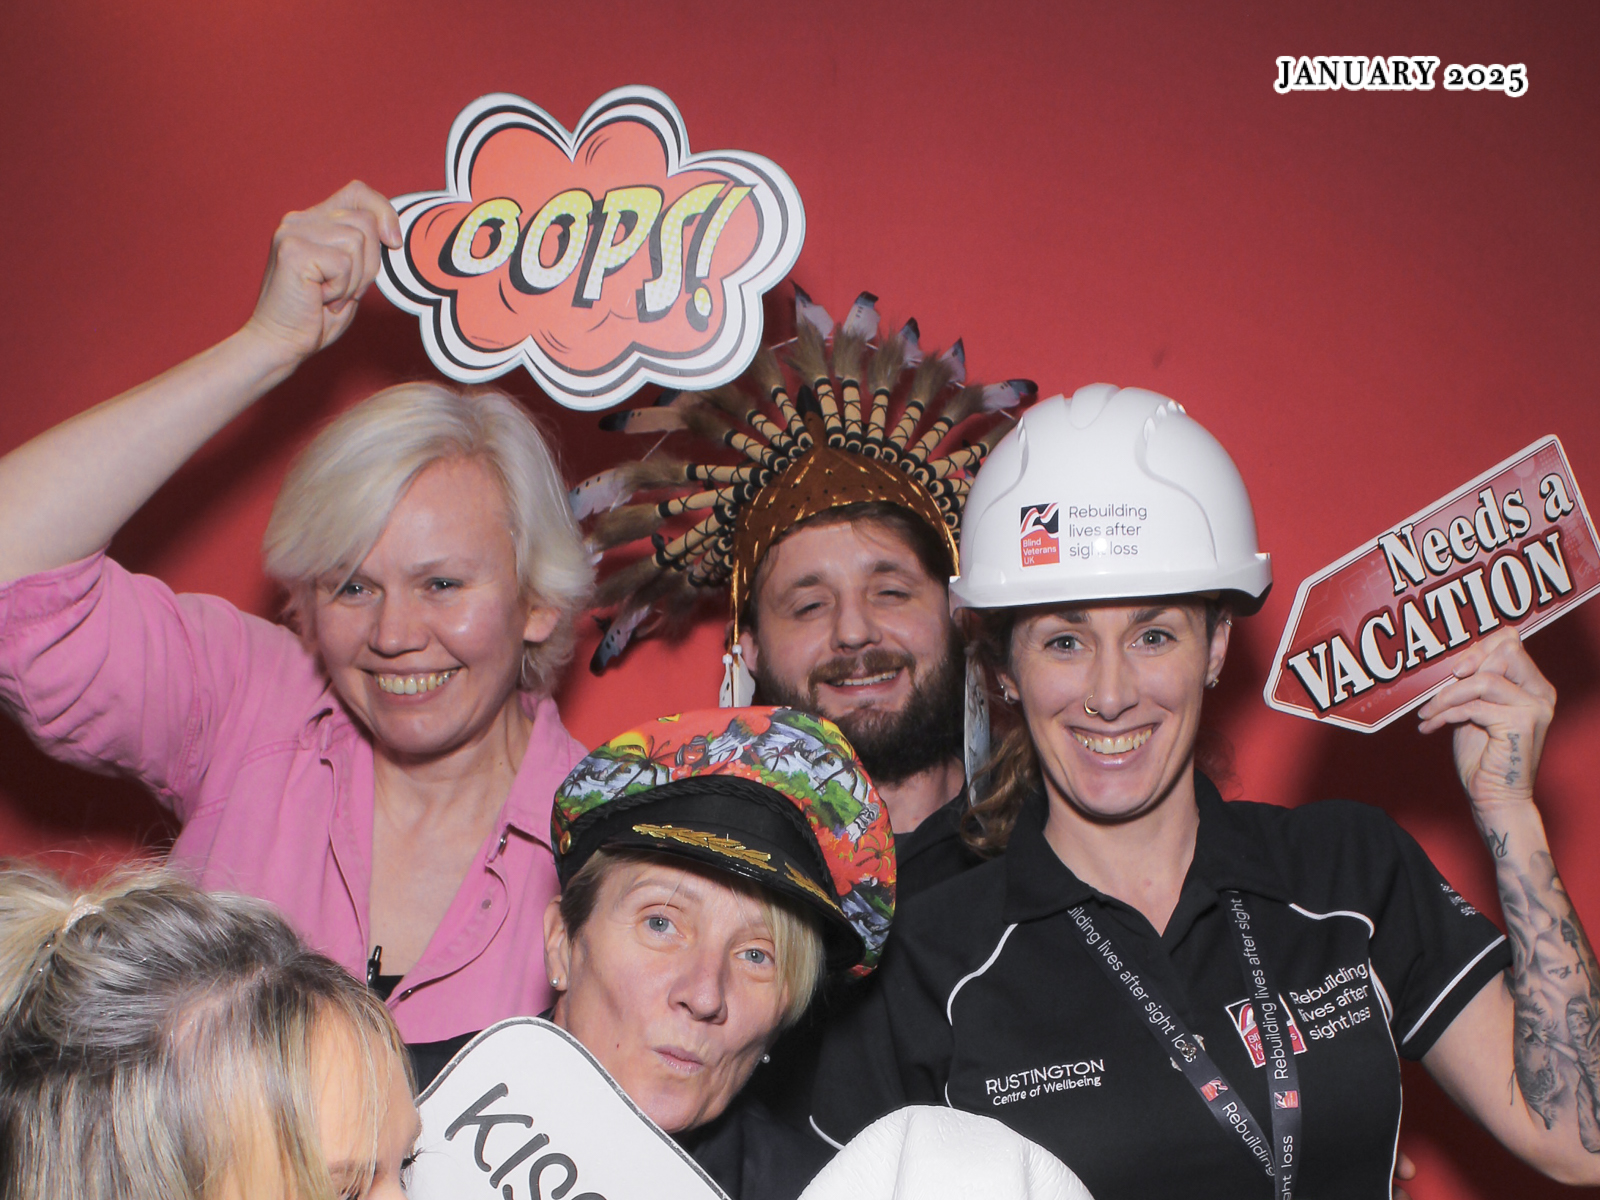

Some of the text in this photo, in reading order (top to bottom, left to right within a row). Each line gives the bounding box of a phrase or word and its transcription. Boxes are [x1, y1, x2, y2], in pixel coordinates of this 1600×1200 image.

[444, 181, 758, 325] OOPS!
[1068, 503, 1147, 520] Rebuilding
[1023, 538, 1042, 548] Blind
[1069, 521, 1141, 538] lives after
[1379, 473, 1575, 594] Needs a
[1023, 546, 1057, 556] Veterans
[1024, 556, 1035, 565] UK
[1109, 541, 1138, 556] loss
[1287, 532, 1574, 712] VACATION
[1097, 939, 1124, 971] lives
[1120, 970, 1149, 1000] after
[1145, 1001, 1175, 1035] sight
[1231, 897, 1288, 1080] Rebuilding lives after sight
[1288, 963, 1369, 1005] Rebuilding
[1298, 984, 1369, 1022] lives after
[1309, 1006, 1371, 1040] sight loss
[985, 1058, 1106, 1095] RUSTINGTON
[992, 1075, 1102, 1106] Centre of Wellbeing
[1222, 1101, 1276, 1177] Rebuilding
[1281, 1135, 1294, 1169] loss
